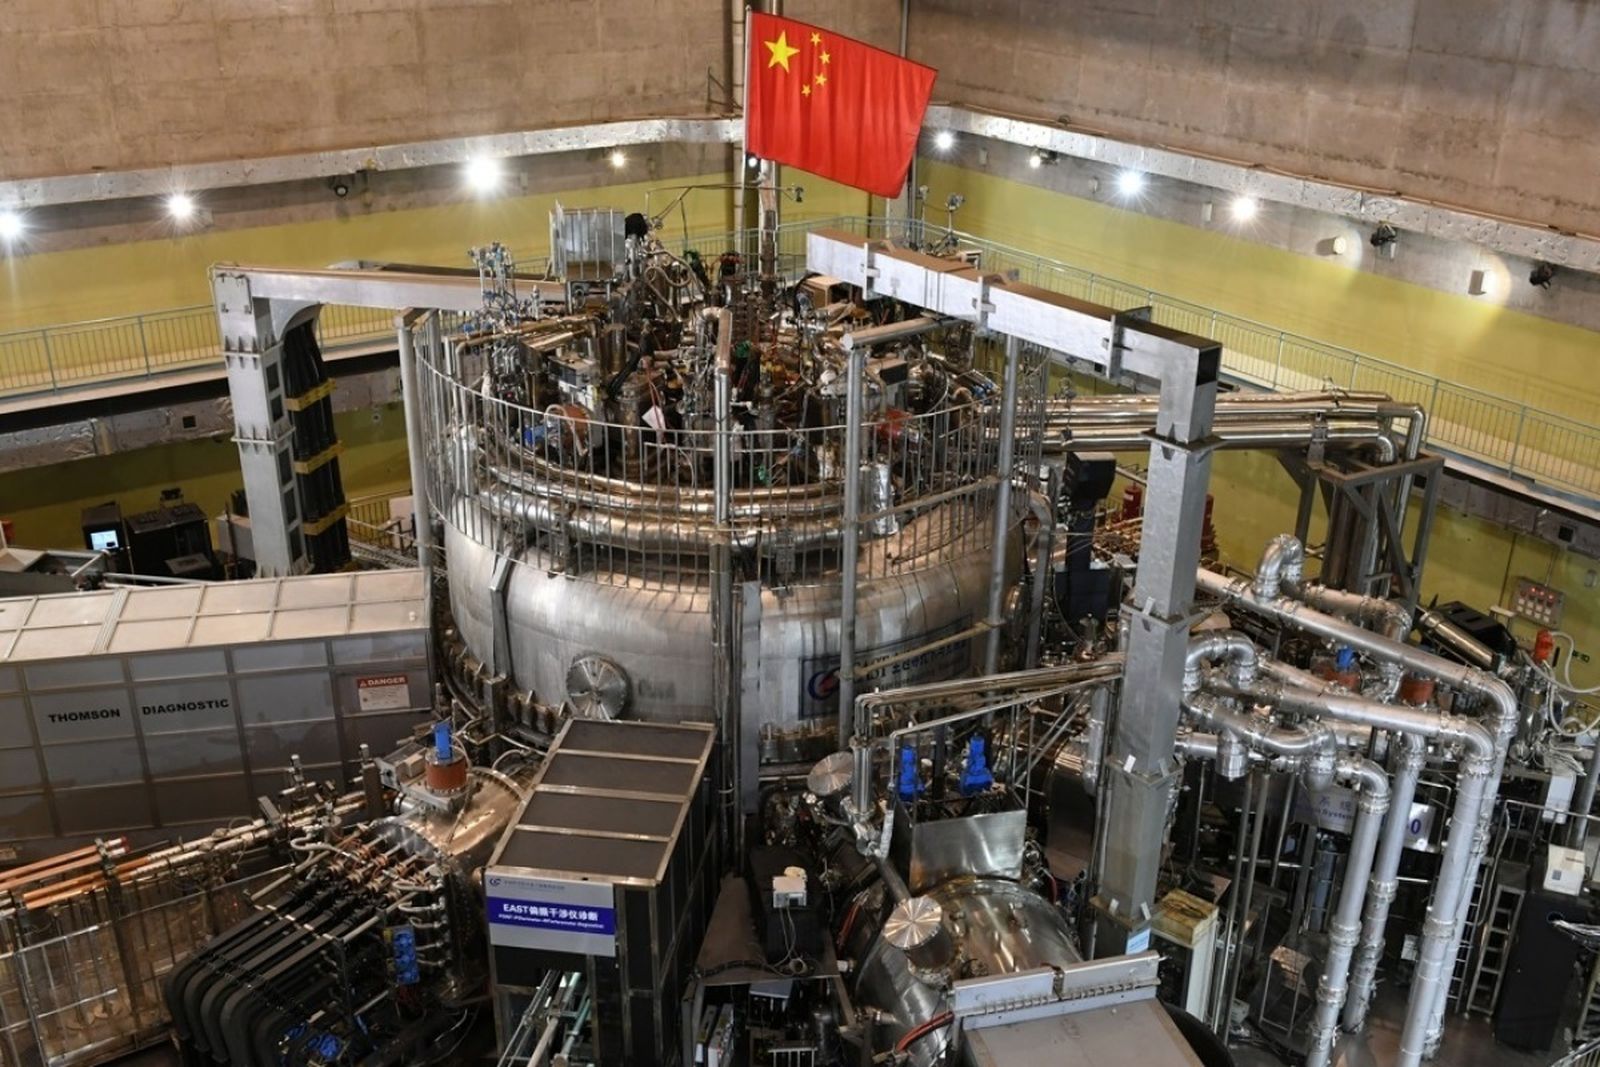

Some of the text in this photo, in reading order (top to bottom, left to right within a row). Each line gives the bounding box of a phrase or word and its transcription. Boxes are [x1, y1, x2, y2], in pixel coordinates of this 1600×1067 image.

[367, 676, 406, 686] DANGER
[48, 698, 230, 724] THOMSON DIAGNOSTIC
